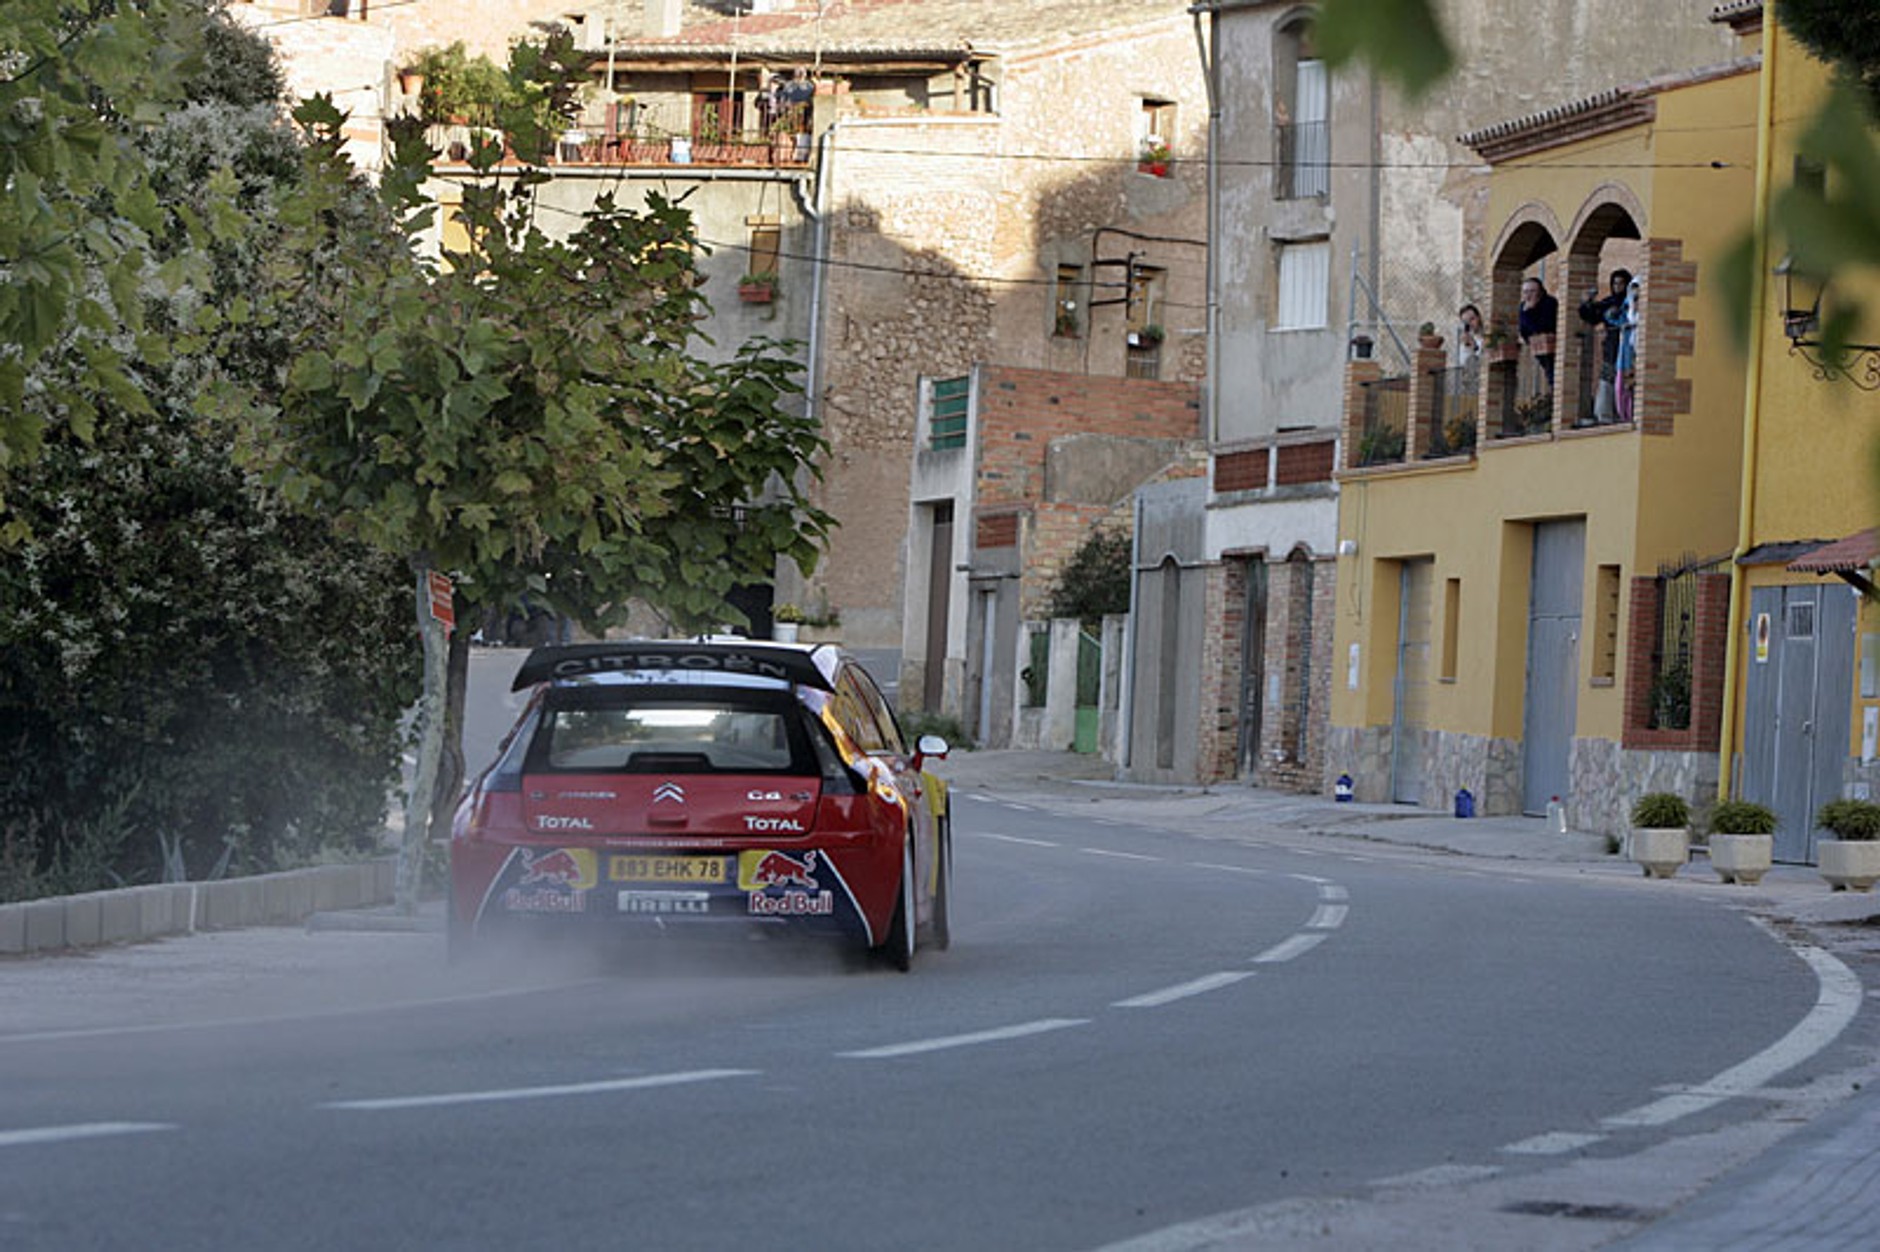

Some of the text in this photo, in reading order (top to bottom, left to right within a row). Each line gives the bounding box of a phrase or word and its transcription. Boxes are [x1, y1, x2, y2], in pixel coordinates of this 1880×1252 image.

[537, 815, 593, 828] TOTAL
[744, 816, 804, 831] TOTAL
[655, 860, 692, 877] EHK
[699, 860, 720, 877] 78
[618, 890, 709, 912] PIRELLI
[749, 890, 833, 915] Red Bull
